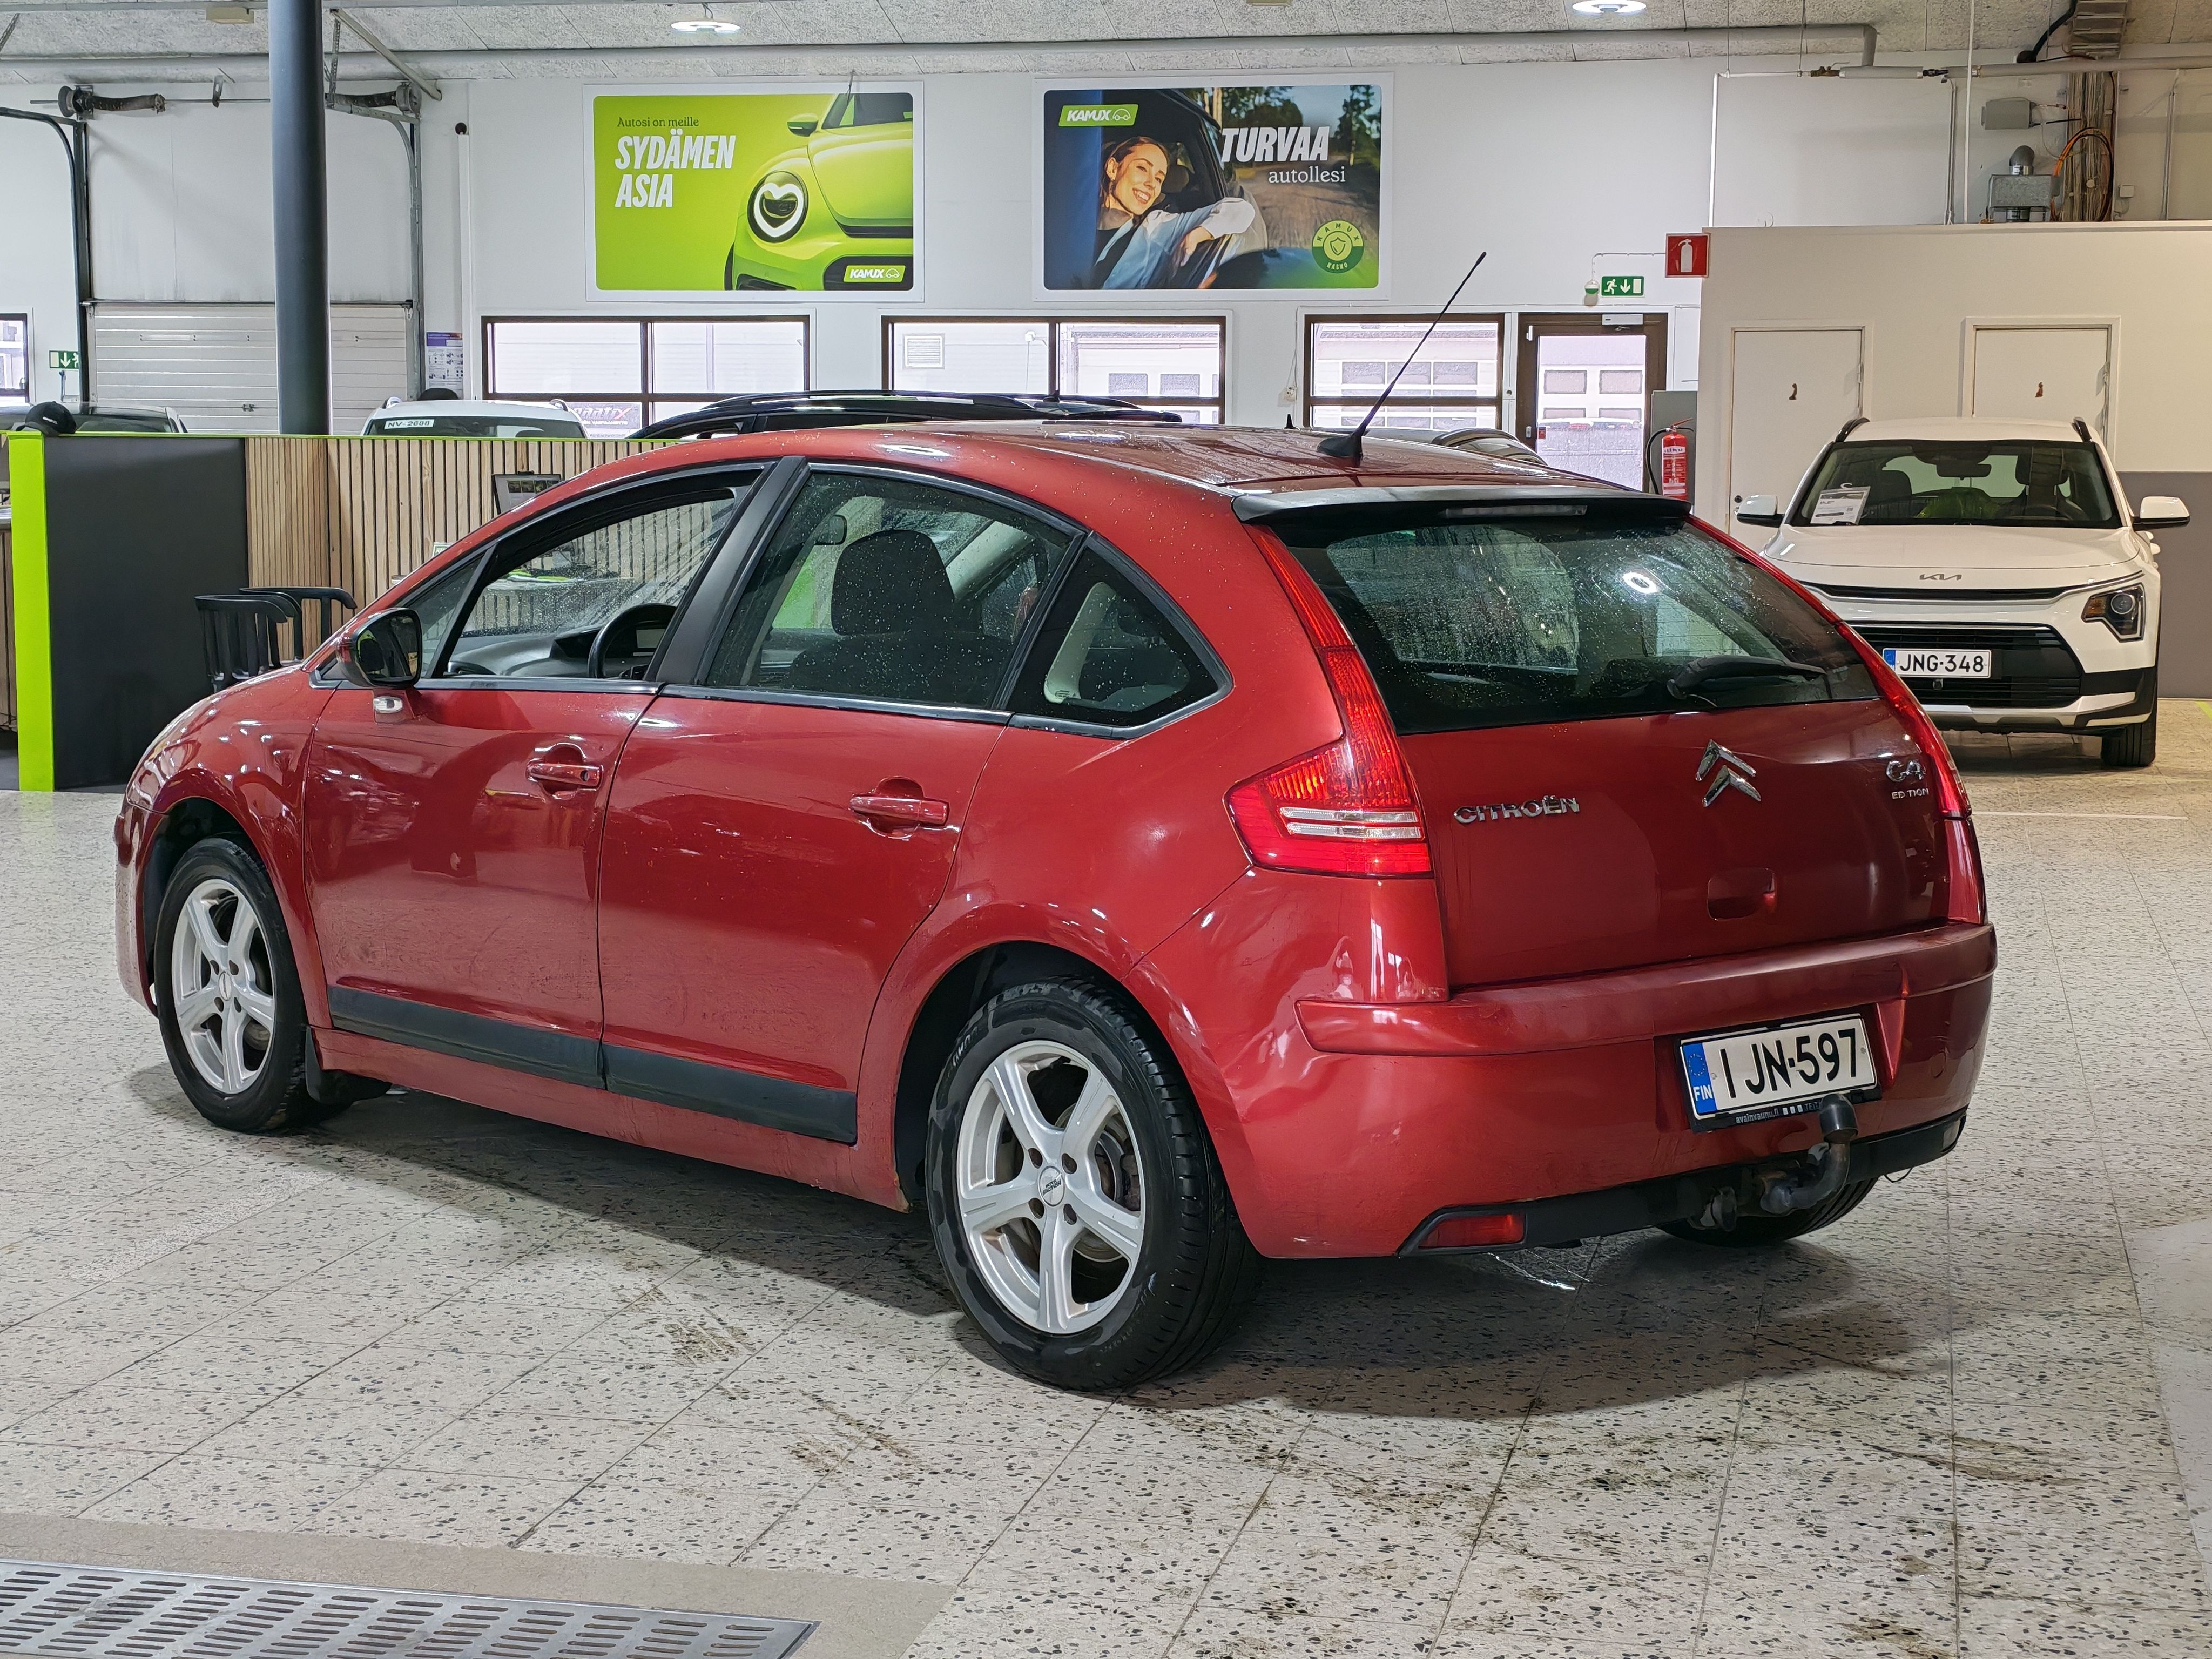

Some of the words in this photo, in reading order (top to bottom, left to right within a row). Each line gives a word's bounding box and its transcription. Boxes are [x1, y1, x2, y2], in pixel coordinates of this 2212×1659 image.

[617, 117, 650, 127] Autosi
[652, 118, 665, 127] on
[668, 117, 699, 127] meille
[1067, 110, 1112, 122] KAMUX
[615, 128, 736, 170] SYDÄMEN
[1221, 126, 1330, 162] TURVAA
[1269, 166, 1346, 183] autollesi
[615, 174, 673, 207] ASIA
[1317, 223, 1359, 242] KAMUX
[849, 269, 885, 278] KAMUX
[1899, 653, 1984, 673] JNG-348
[1886, 760, 1926, 782] C4
[1891, 788, 1929, 800] EDTION
[1453, 795, 1580, 824] CITROËN
[1719, 1028, 1857, 1098] IJN-597
[1693, 1084, 1713, 1101] FIN
